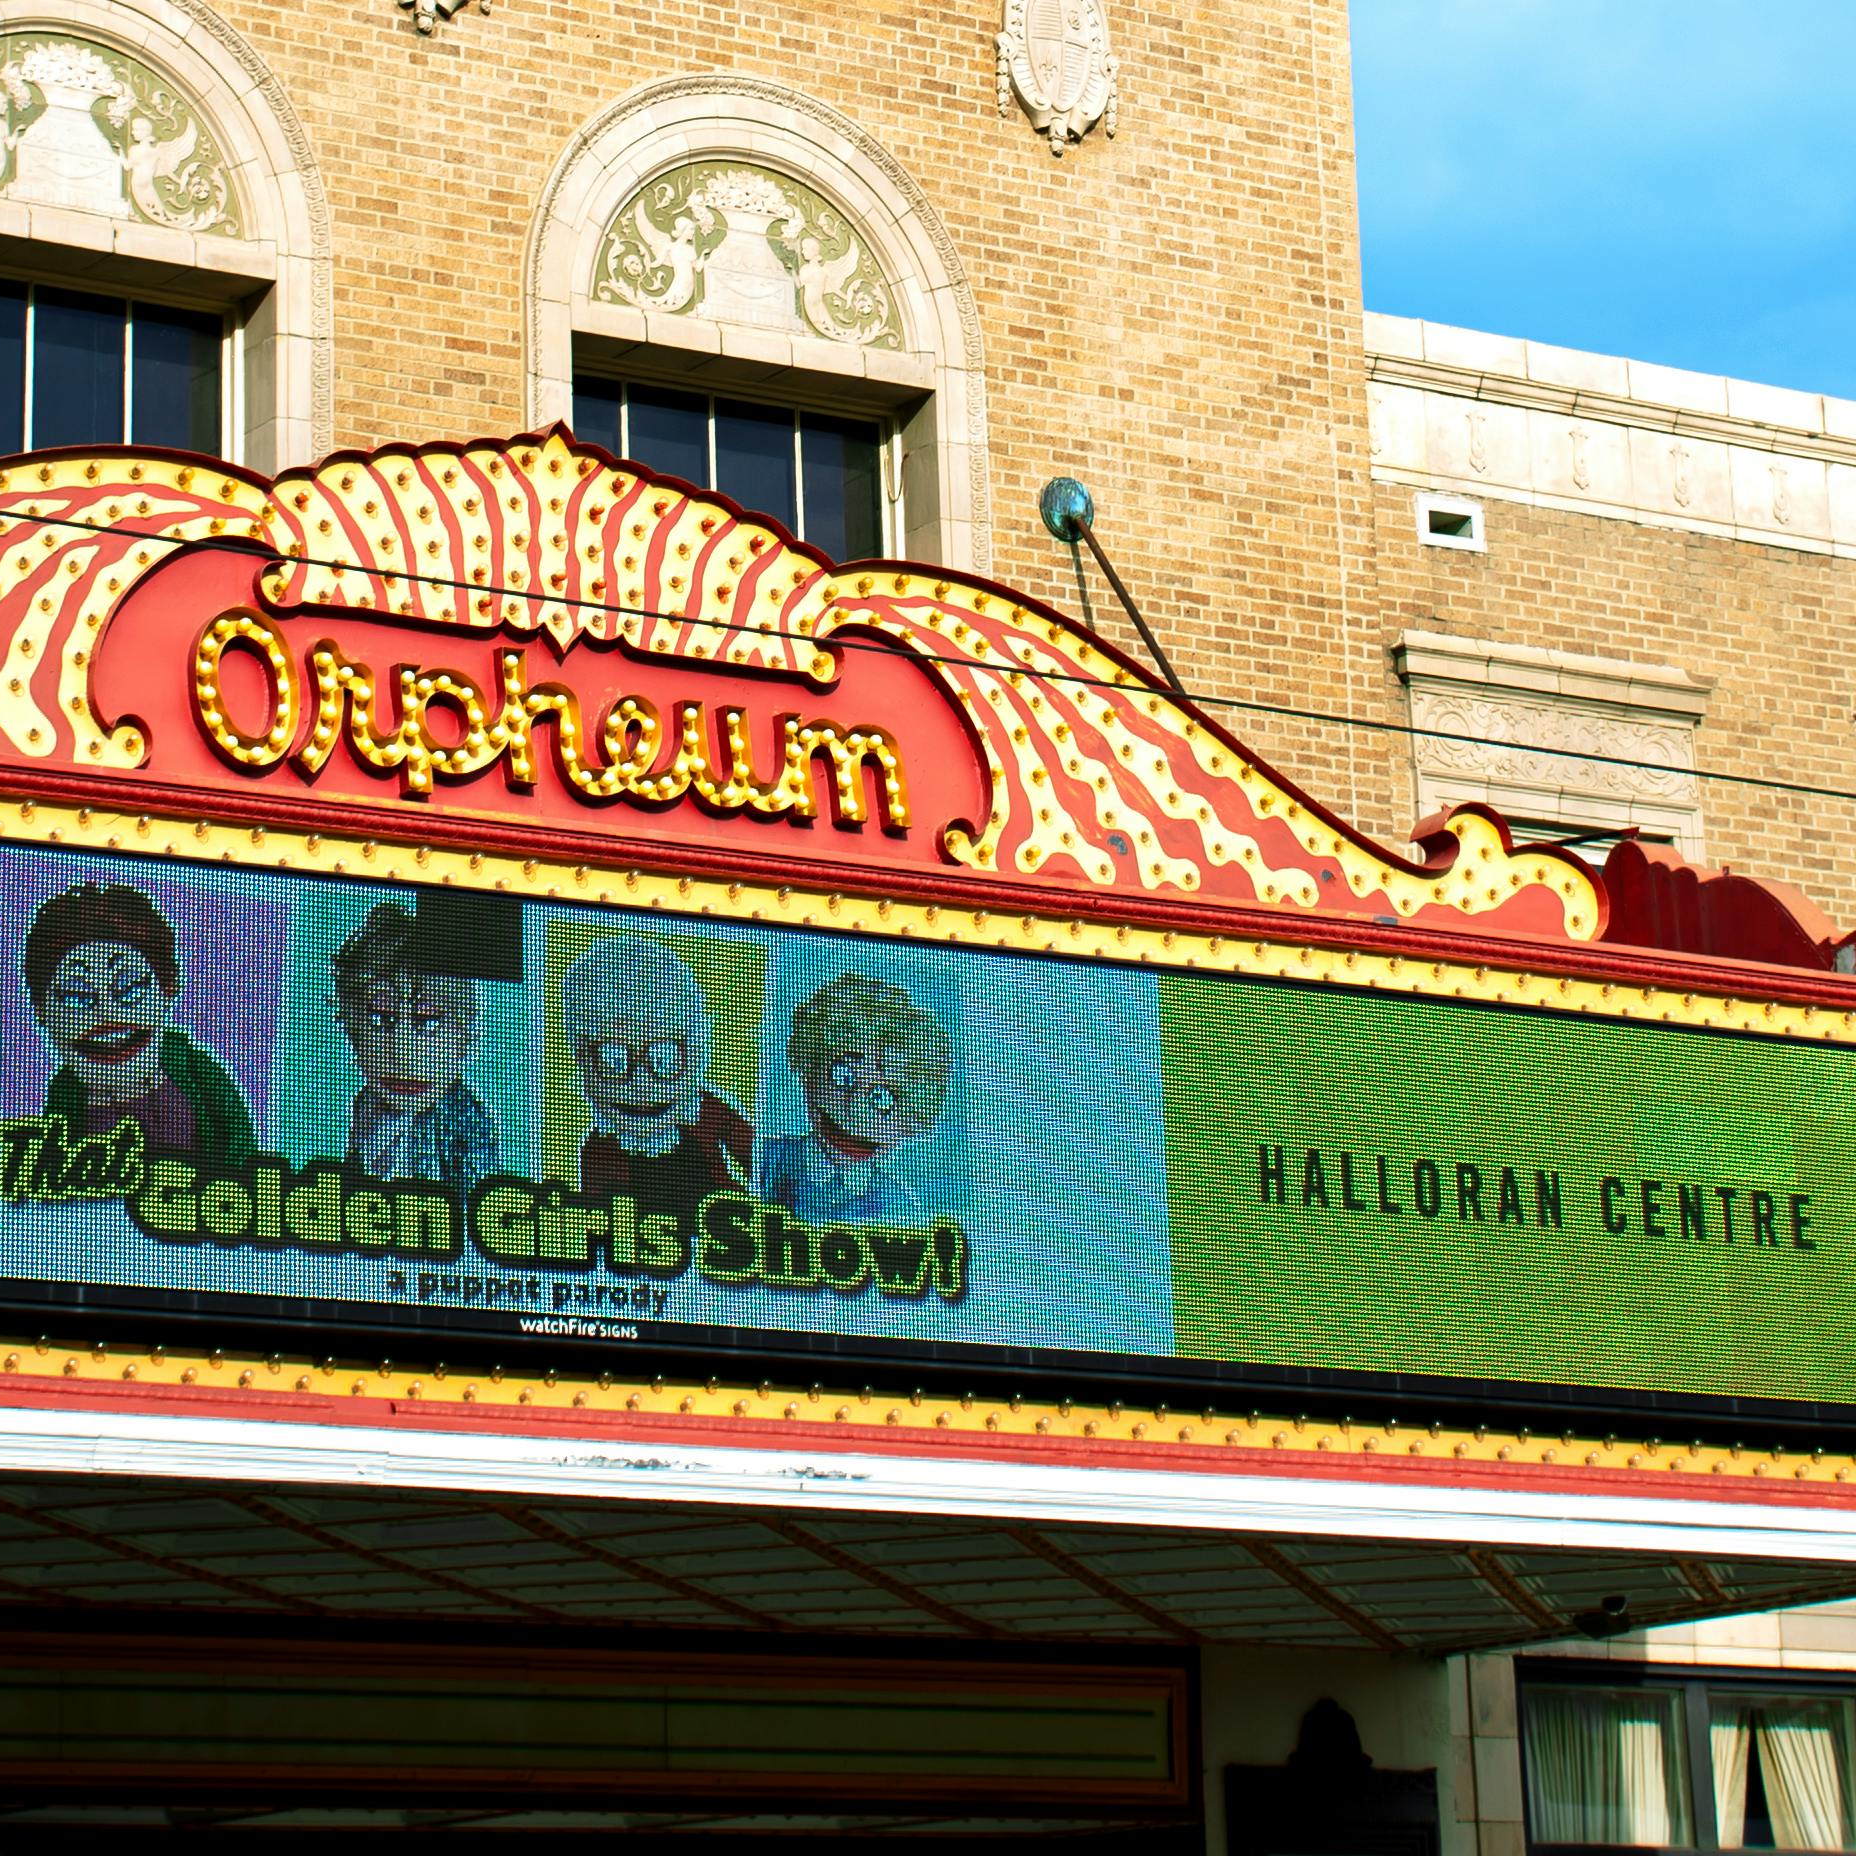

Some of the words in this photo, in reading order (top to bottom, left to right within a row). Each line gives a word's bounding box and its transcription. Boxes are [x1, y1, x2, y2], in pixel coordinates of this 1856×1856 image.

[189, 607, 912, 836] Orpheum
[139, 1159, 451, 1250] Golden
[475, 1186, 682, 1268] Girls
[697, 1189, 965, 1299] Show!
[1257, 1144, 1563, 1229] HALLORAN
[1600, 1175, 1818, 1251] CENTRE
[387, 1270, 408, 1291] a
[419, 1270, 541, 1306] puppet
[552, 1278, 669, 1316] parody
